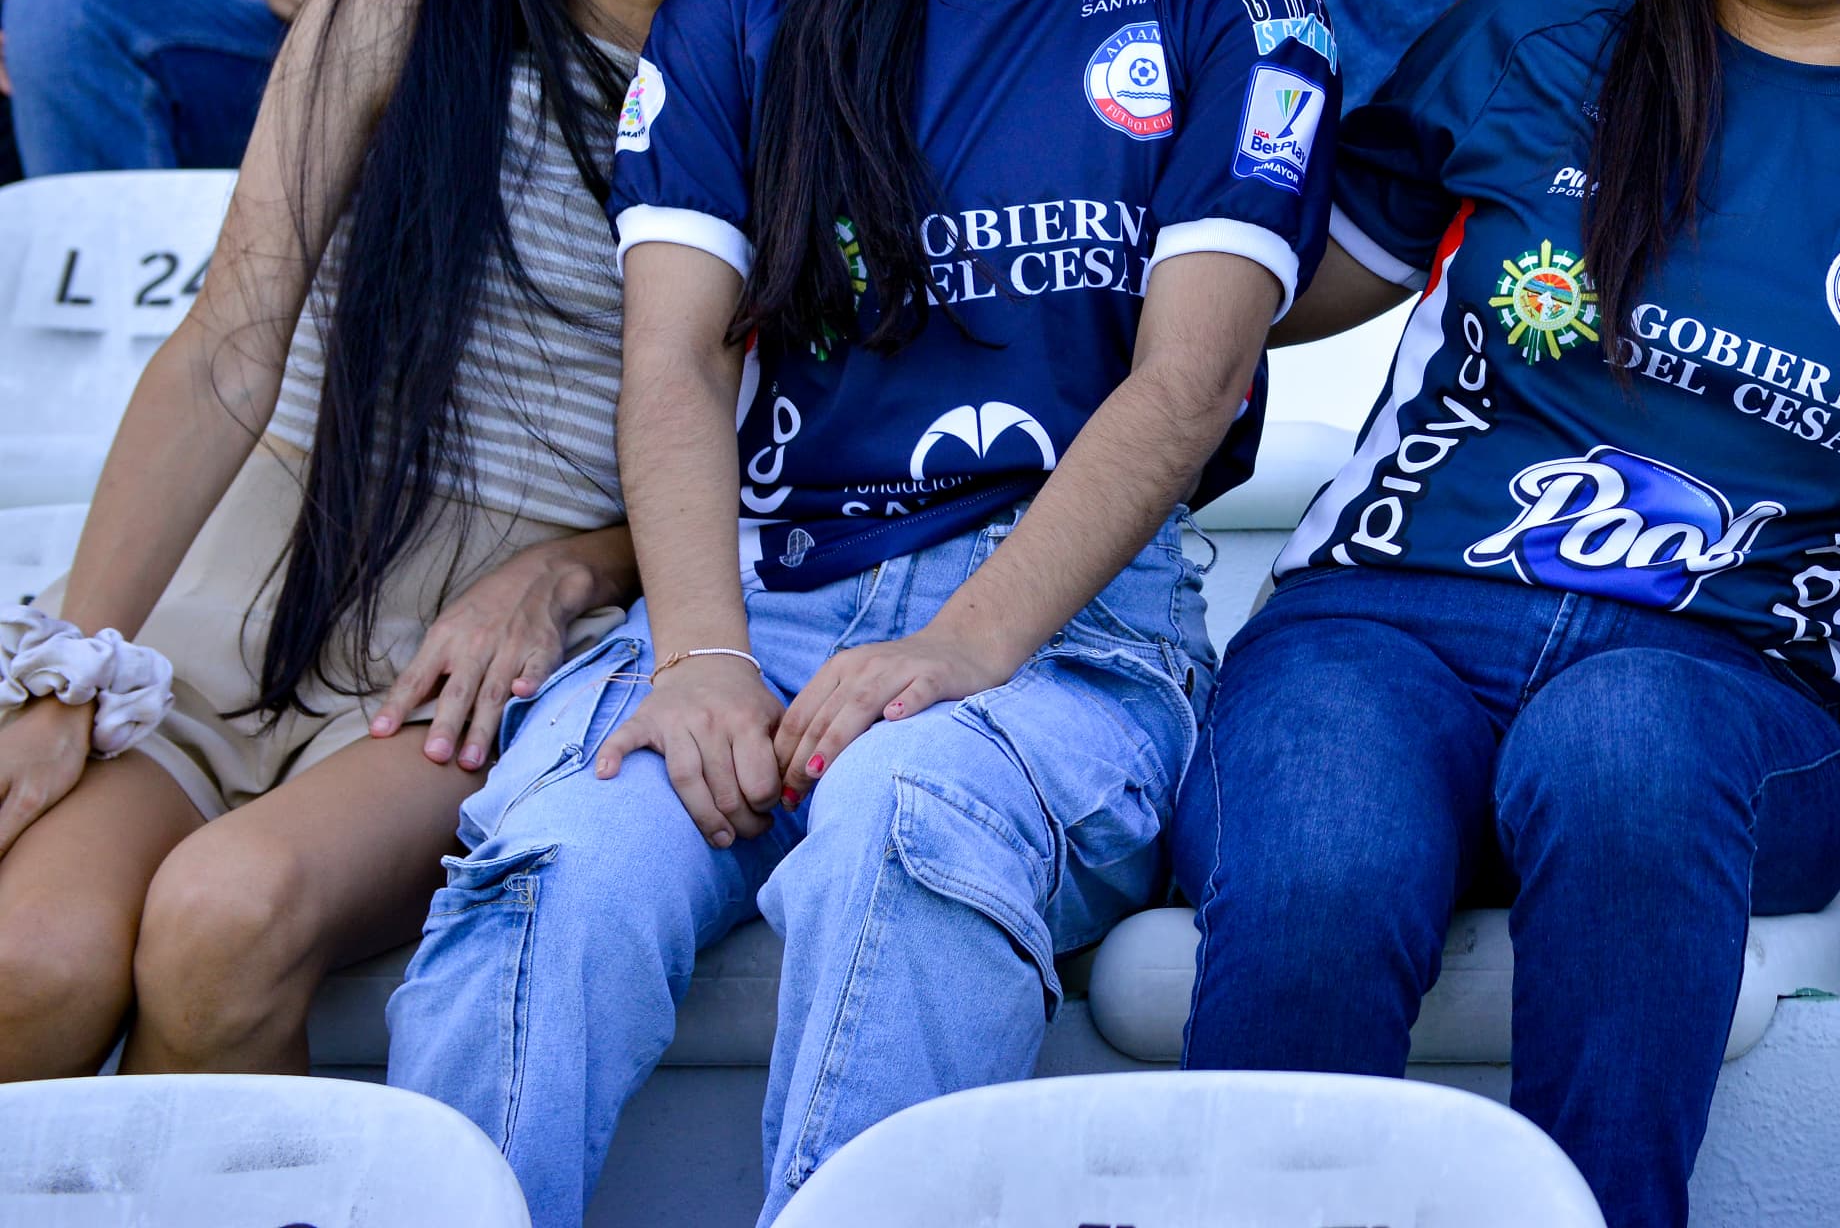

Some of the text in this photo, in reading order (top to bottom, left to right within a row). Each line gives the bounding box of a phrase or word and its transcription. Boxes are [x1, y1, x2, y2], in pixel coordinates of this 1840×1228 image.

[1105, 104, 1152, 131] FÚTBOL
[1253, 128, 1270, 139] LIGA
[1250, 135, 1306, 166] BetPlay
[921, 199, 1147, 258] OBIERN
[56, 249, 92, 304] L
[903, 259, 996, 306] EL
[1604, 336, 1706, 395] DEL
[1332, 312, 1490, 565] play.co
[1465, 458, 1787, 574] Pool
